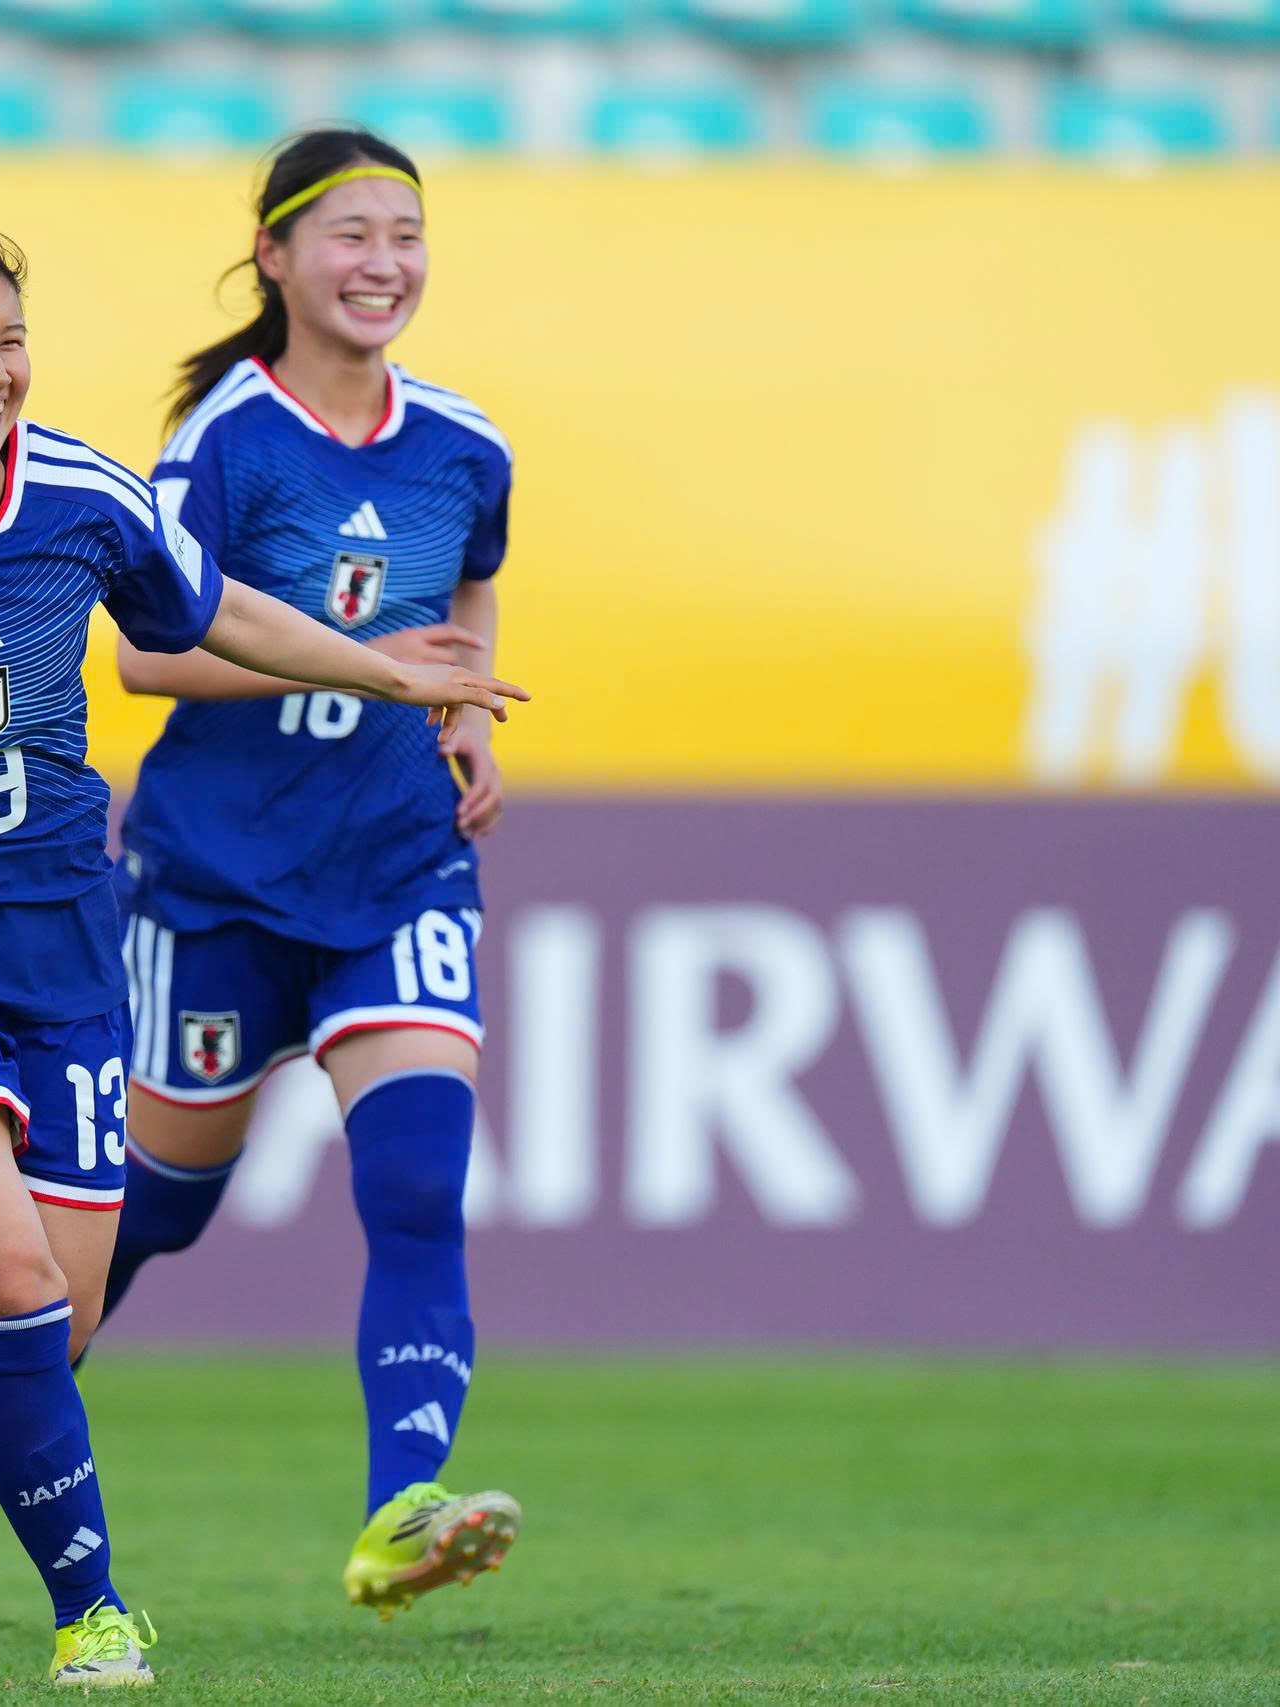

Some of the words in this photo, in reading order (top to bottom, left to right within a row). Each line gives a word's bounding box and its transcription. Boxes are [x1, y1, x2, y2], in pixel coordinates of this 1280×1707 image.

[393, 909, 470, 1003] 18
[66, 1057, 126, 1170] 13
[377, 1343, 471, 1386] JAPAN
[19, 1457, 94, 1506] JAPAN
